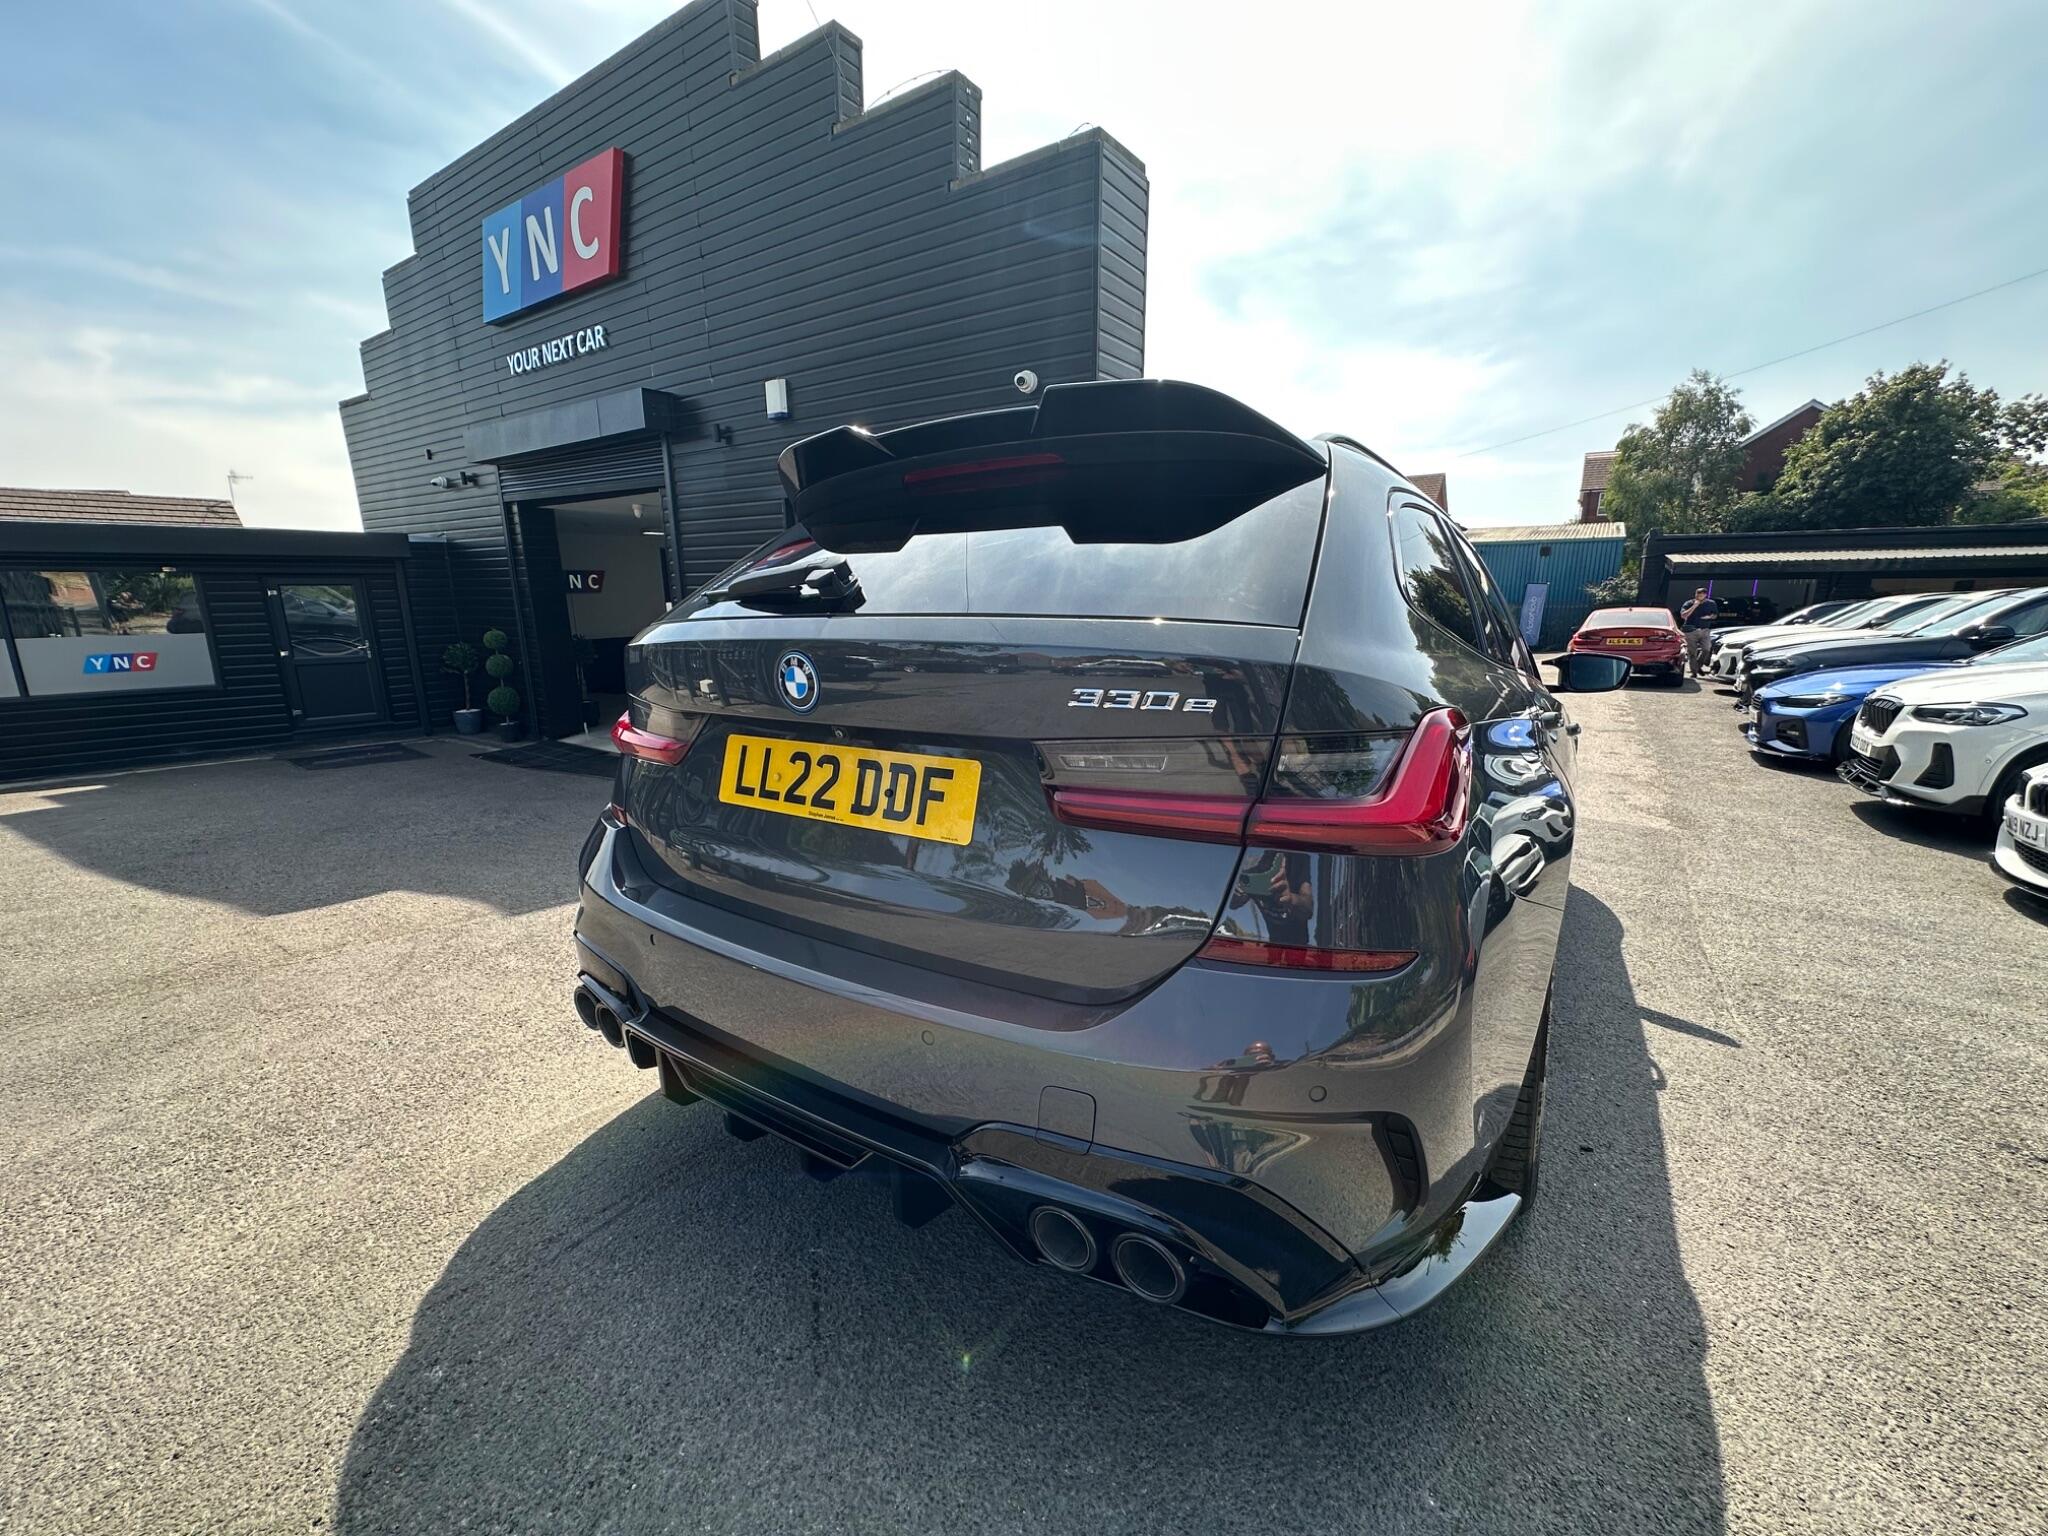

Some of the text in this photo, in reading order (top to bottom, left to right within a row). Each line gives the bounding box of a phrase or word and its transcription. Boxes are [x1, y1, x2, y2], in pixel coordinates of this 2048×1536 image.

[487, 185, 600, 296] YNC
[506, 324, 605, 376] YOUR NEXT CAR
[568, 574, 600, 589] NC
[89, 655, 151, 671] YNC
[1067, 687, 1219, 715] 330e
[734, 744, 955, 826] LL22 DDF
[2019, 819, 2039, 841] NZJ
